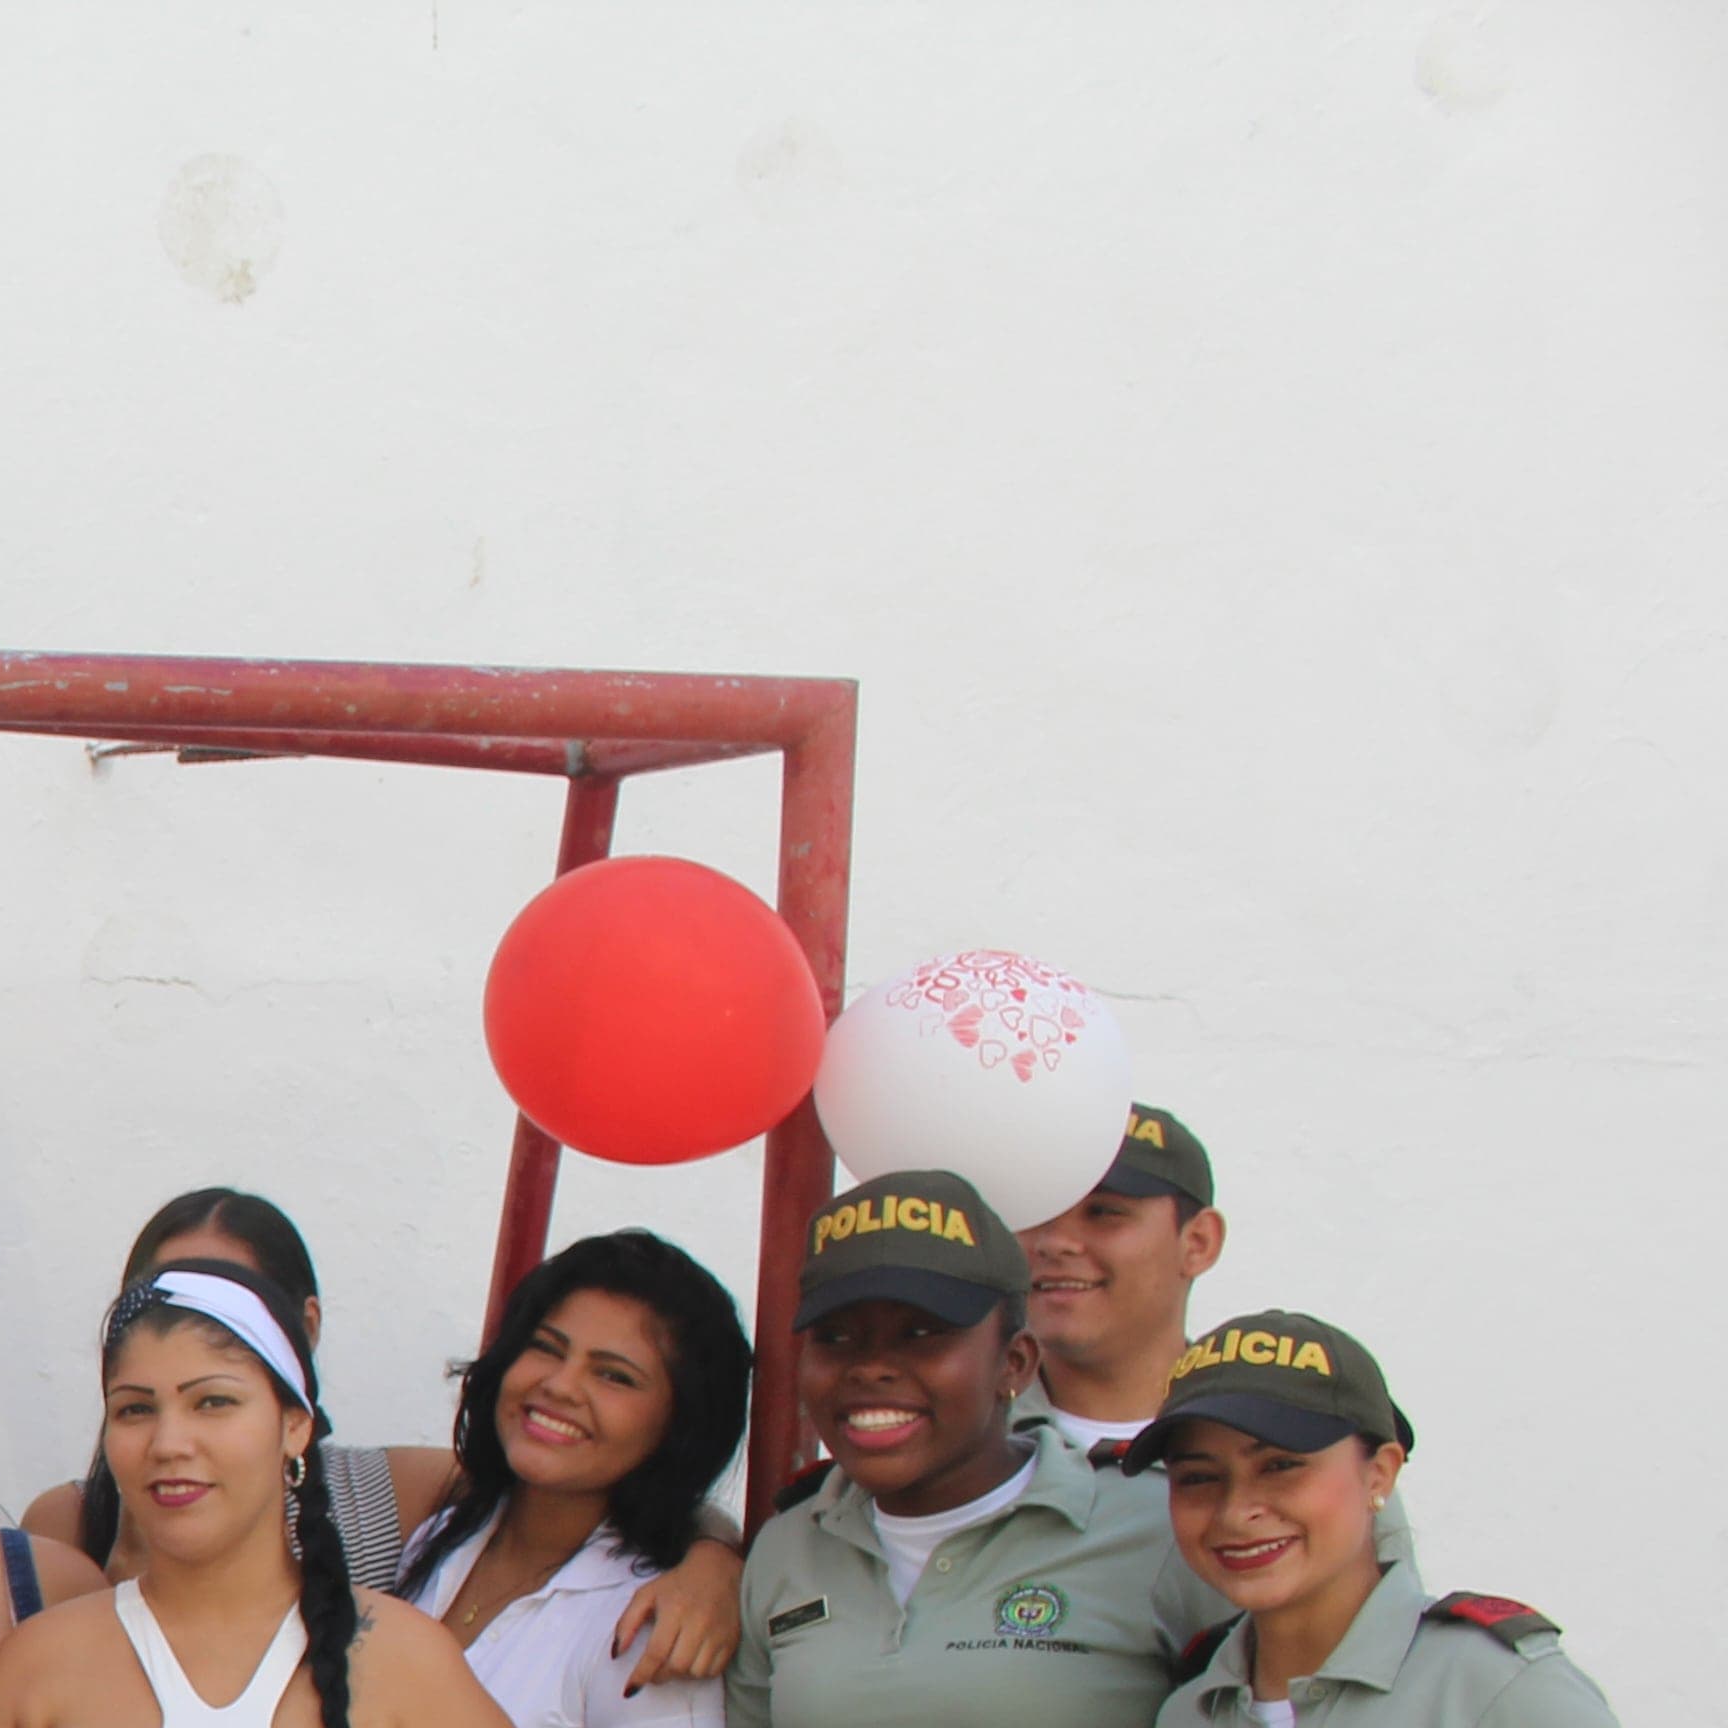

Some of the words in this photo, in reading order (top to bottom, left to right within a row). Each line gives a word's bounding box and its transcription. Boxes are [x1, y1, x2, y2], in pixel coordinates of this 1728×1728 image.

[814, 1196, 975, 1255] POLICIA
[1162, 1328, 1332, 1400] POLICIA
[946, 1639, 1009, 1650] POLICIA
[1013, 1639, 1090, 1654] NACIONAL
